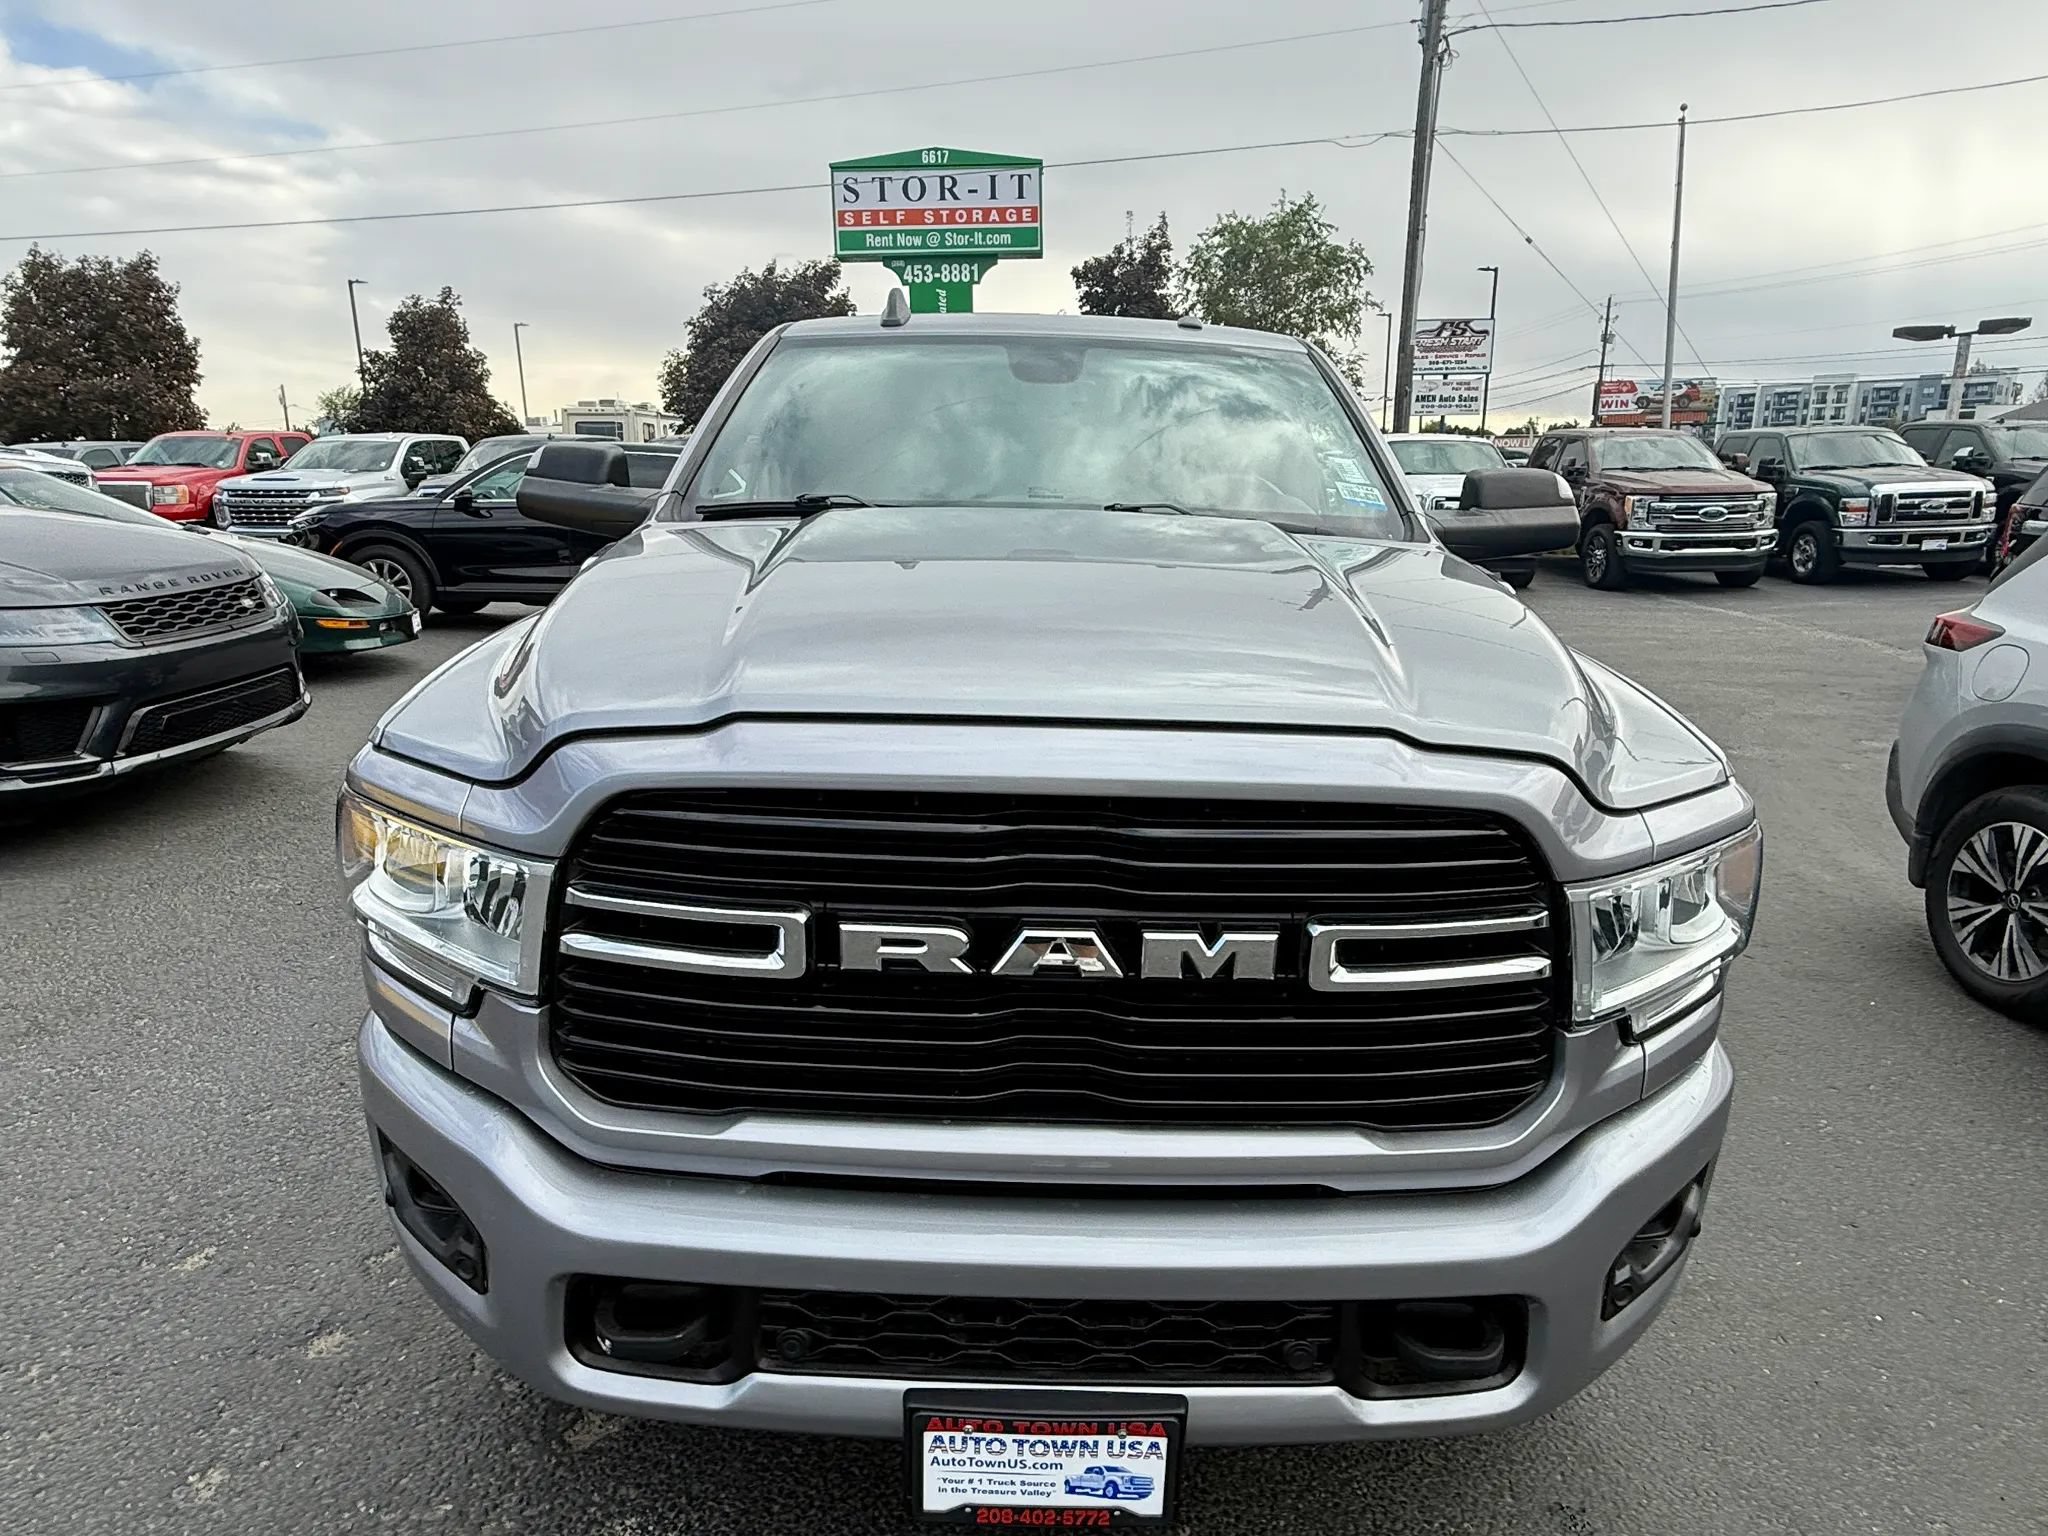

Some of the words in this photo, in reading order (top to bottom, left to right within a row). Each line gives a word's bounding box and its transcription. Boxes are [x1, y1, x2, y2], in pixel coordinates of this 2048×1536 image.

[922, 150, 949, 164] 6617
[842, 173, 1032, 204] STOR-IT
[844, 211, 905, 225] SELF
[924, 208, 1032, 224] STORAGE
[866, 233, 893, 247] Rent
[897, 233, 922, 247] Now
[926, 232, 941, 247] @
[945, 231, 1011, 246] Stor-It.com
[903, 263, 979, 283] 453-8881
[1415, 394, 1437, 403] AMEN
[1439, 394, 1455, 403] Auto
[1458, 394, 1479, 403] Sales
[1601, 399, 1629, 409] WIN
[1495, 438, 1520, 448] NOW
[98, 578, 180, 596] RANGE
[187, 568, 244, 584] ROVER
[838, 921, 1280, 980] RAM
[926, 1416, 1004, 1434] AUTO
[1013, 1420, 1098, 1435] TOWN
[1108, 1422, 1167, 1437] USA
[928, 1434, 1008, 1456] AUTO
[1012, 1438, 1099, 1458] TOWN
[1107, 1440, 1164, 1460] USA
[930, 1455, 1063, 1471] AutoTownUS.com
[987, 1478, 1016, 1486] Truck
[971, 1487, 1017, 1495] Treasure
[976, 1508, 1111, 1526] 208-402-5772
